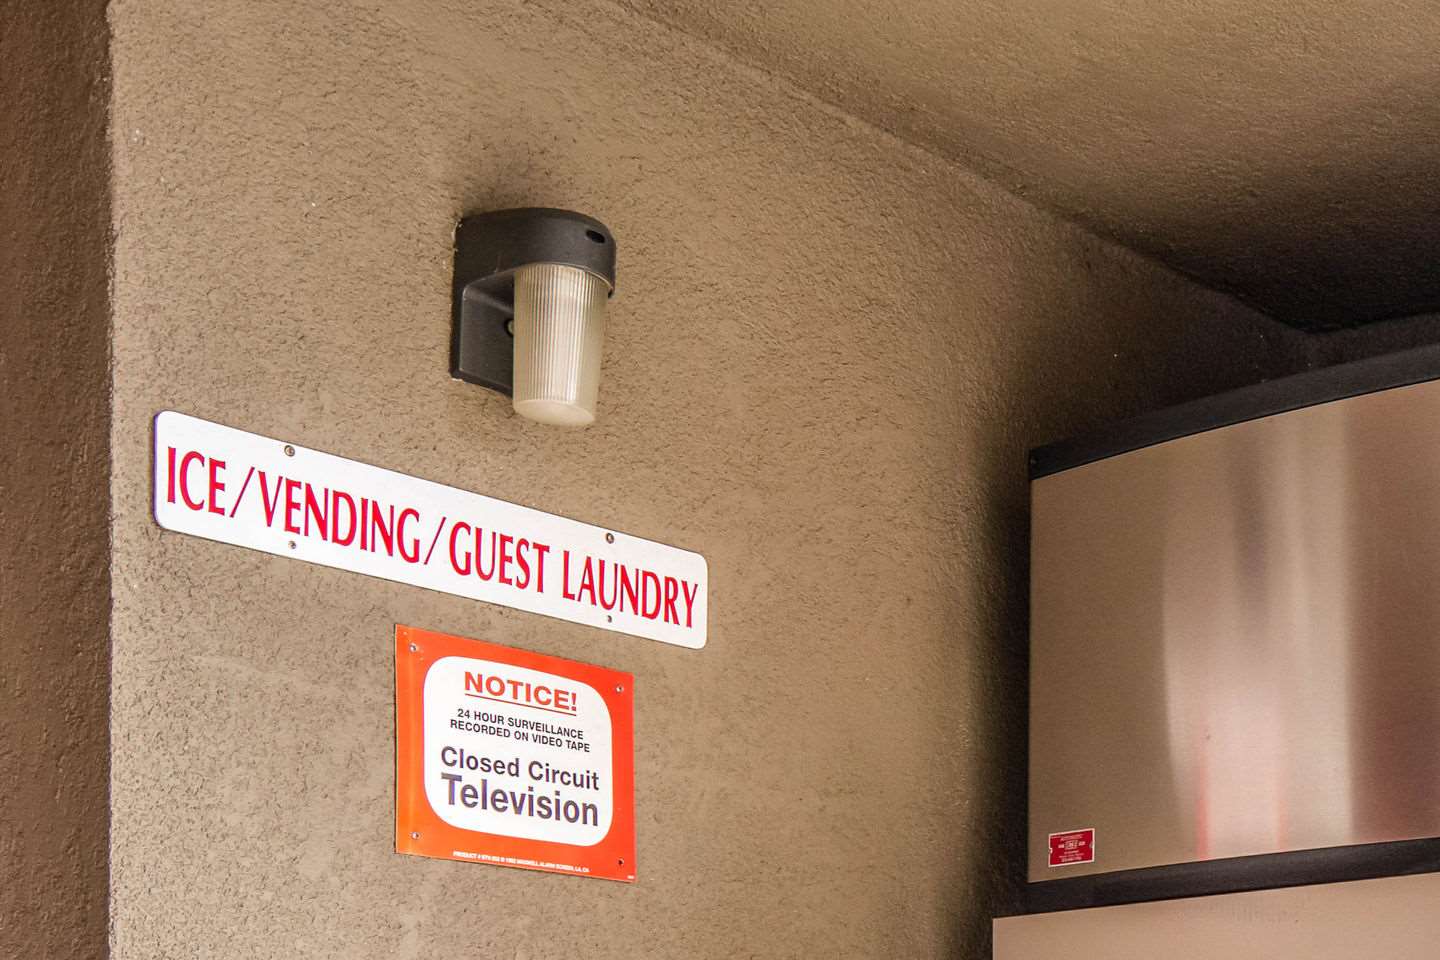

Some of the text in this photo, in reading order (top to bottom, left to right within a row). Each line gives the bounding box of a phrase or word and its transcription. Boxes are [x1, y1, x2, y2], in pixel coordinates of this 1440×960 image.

[167, 446, 698, 628] ICE/VENDING/GUEST LAUNDRY
[465, 671, 577, 712] NOTICE!
[450, 719, 590, 753] RECORDED ON VIDEO TAPE
[457, 708, 584, 740] 24 HOUR SURVEILLANCE
[441, 746, 600, 790] Closed Circuit
[441, 772, 598, 826] Television
